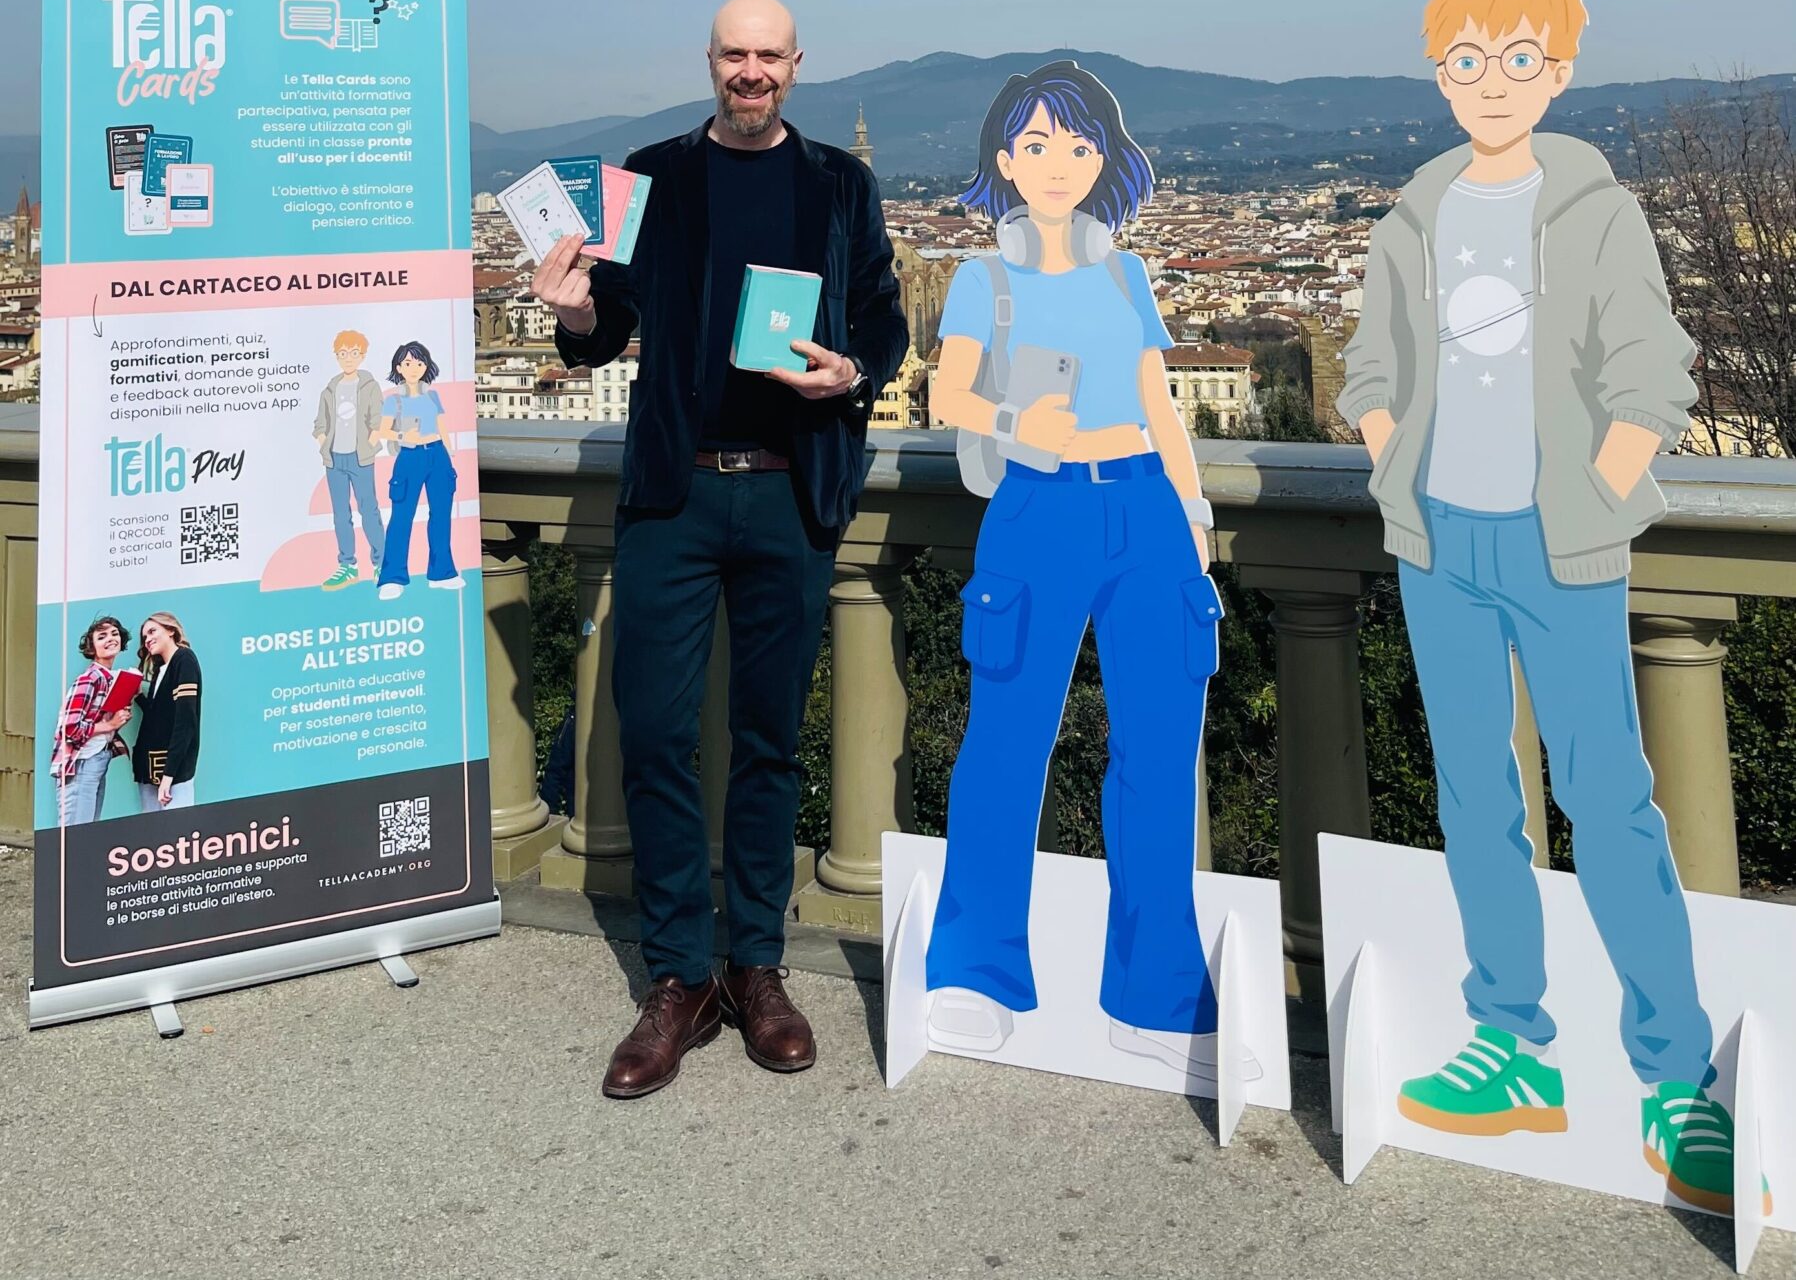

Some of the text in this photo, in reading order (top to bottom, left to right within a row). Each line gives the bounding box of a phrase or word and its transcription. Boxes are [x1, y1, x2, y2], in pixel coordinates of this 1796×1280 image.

[117, 56, 219, 107] Cards
[284, 74, 411, 85] Le Tella Cards sono
[348, 89, 411, 100] formativa
[237, 104, 412, 120] partecipativa, pensata per
[262, 120, 412, 134] essere utilizzata con gli
[251, 136, 413, 150] studenti in classe pronte
[277, 152, 323, 163] all'uso
[326, 153, 348, 166] per
[357, 151, 412, 163] docenti!
[272, 183, 413, 197] L'obiettivo è stimolare
[283, 199, 414, 215] dialogo, confronto e
[312, 214, 414, 230] pensiero critico.
[111, 270, 408, 298] DAL CARTACEO AL DIGITALE
[110, 332, 266, 354] Approfondimenti, quiz,
[110, 348, 270, 371] gamification, percorsi
[110, 362, 310, 385] formativi, domande guidate
[110, 381, 300, 403] e feedback autorevoli sono
[110, 404, 182, 421] disponibili
[186, 402, 219, 415] nella
[224, 399, 267, 412] nuova
[191, 449, 245, 484] Play
[109, 513, 169, 527] Scansiona
[109, 526, 165, 540] il QRCODE
[109, 540, 173, 554] e scaricala
[109, 557, 148, 568] subito!
[241, 616, 424, 655] BORSE DI STUDIO
[302, 639, 425, 671] ALL'ESTERO
[271, 669, 426, 702] Opportunità educative
[263, 684, 426, 722] per studenti meritevoli.
[280, 703, 426, 734] Per sostenere talento,
[273, 719, 427, 752] motivazione e crescita
[357, 737, 427, 760] personale.
[108, 816, 300, 877] Sostienici.
[106, 853, 308, 896] Iscriviti all'associazione e supporta
[319, 860, 431, 887] TELLAACADEMY.ORG
[106, 875, 262, 911] le nostre attività formative
[106, 887, 276, 926] e le borse di studio all'estero.
